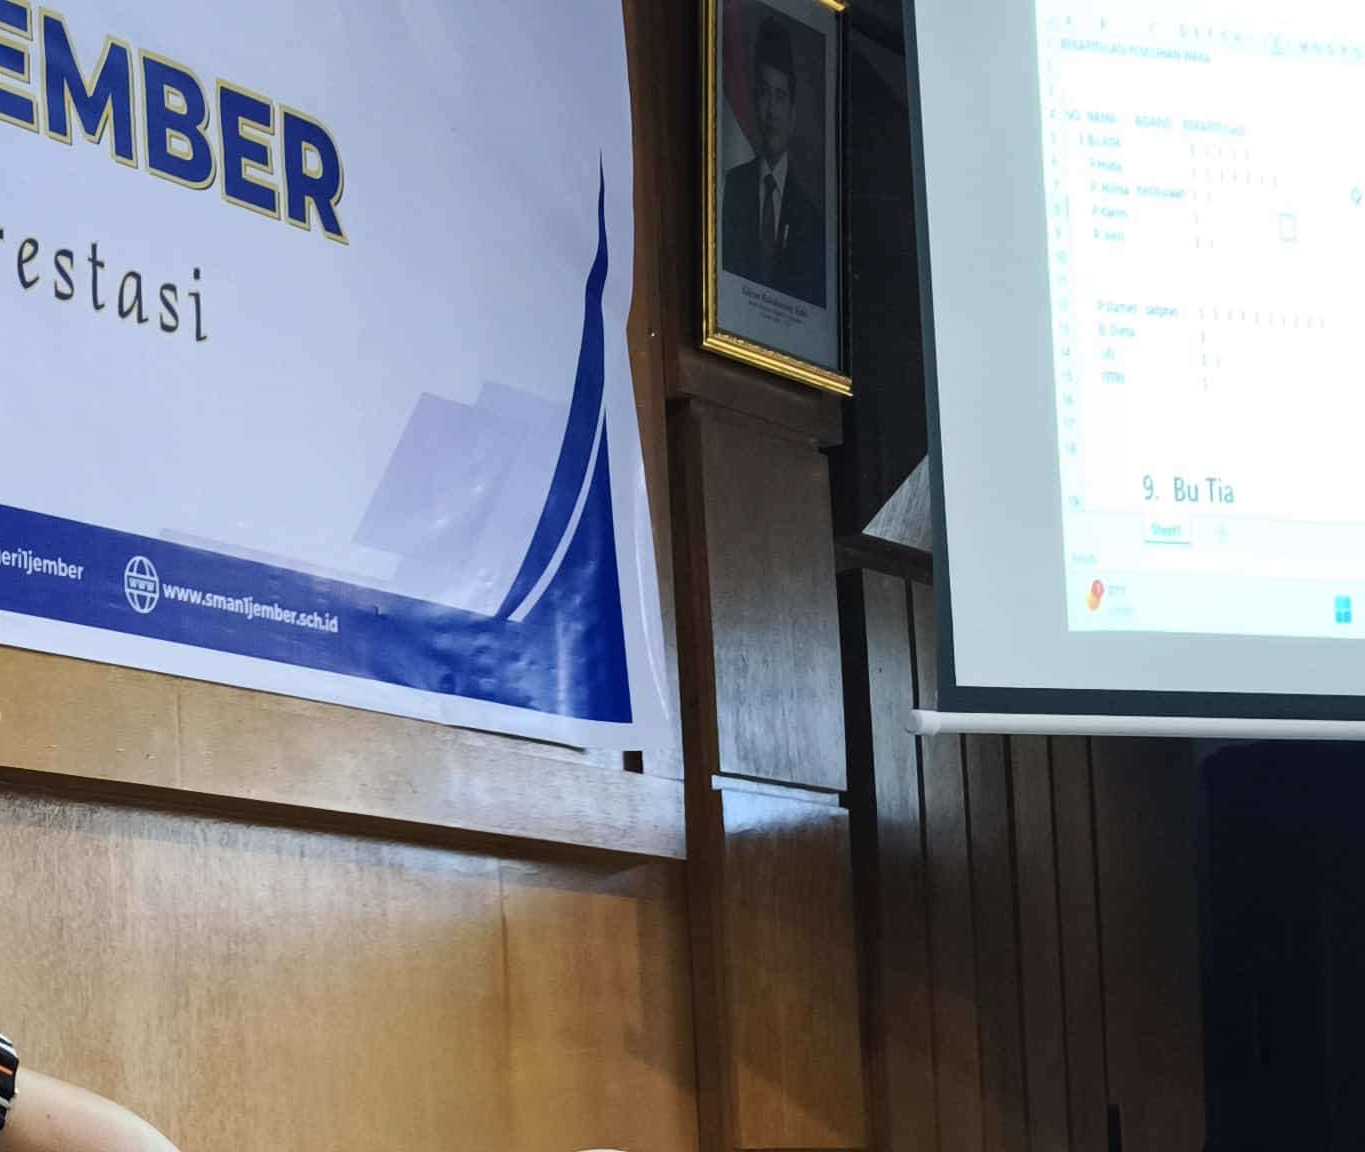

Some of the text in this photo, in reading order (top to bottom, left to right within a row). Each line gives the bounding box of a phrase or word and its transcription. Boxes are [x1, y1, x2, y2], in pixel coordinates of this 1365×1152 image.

[1142, 474, 1235, 504] 9. Bu Tia
[162, 583, 339, 633] www.sman1jember.sch.id
